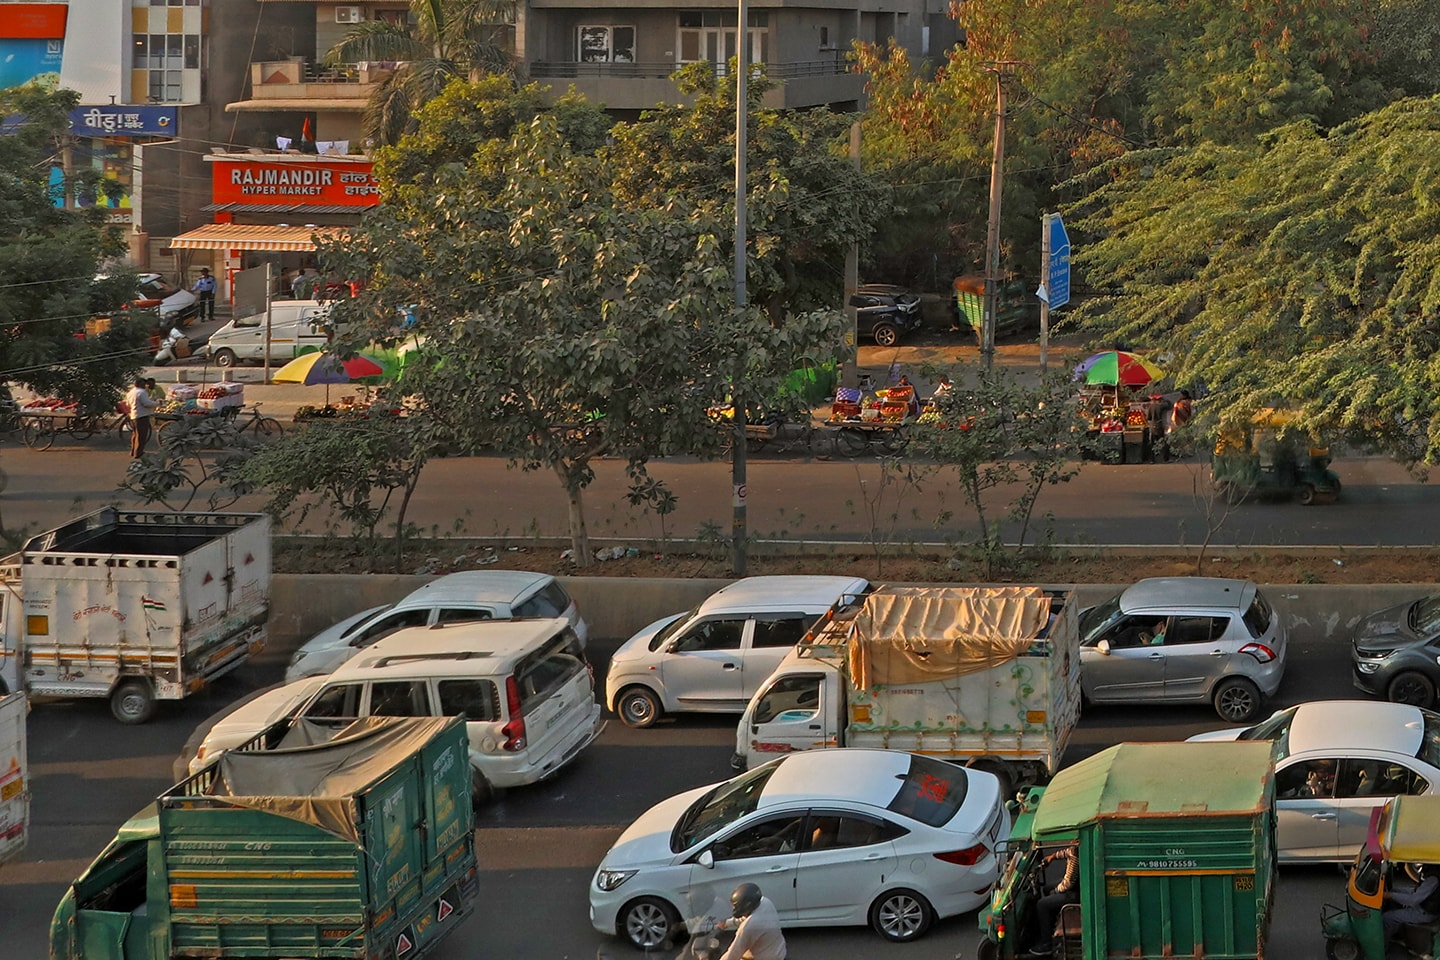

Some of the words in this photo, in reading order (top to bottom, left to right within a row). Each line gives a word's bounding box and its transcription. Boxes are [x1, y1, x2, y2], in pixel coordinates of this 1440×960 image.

[231, 169, 332, 185] RAJMANDIR
[241, 186, 276, 195] HYPER
[279, 186, 322, 195] MARKET
[57, 673, 76, 682] CNG
[1166, 848, 1185, 856] CNG
